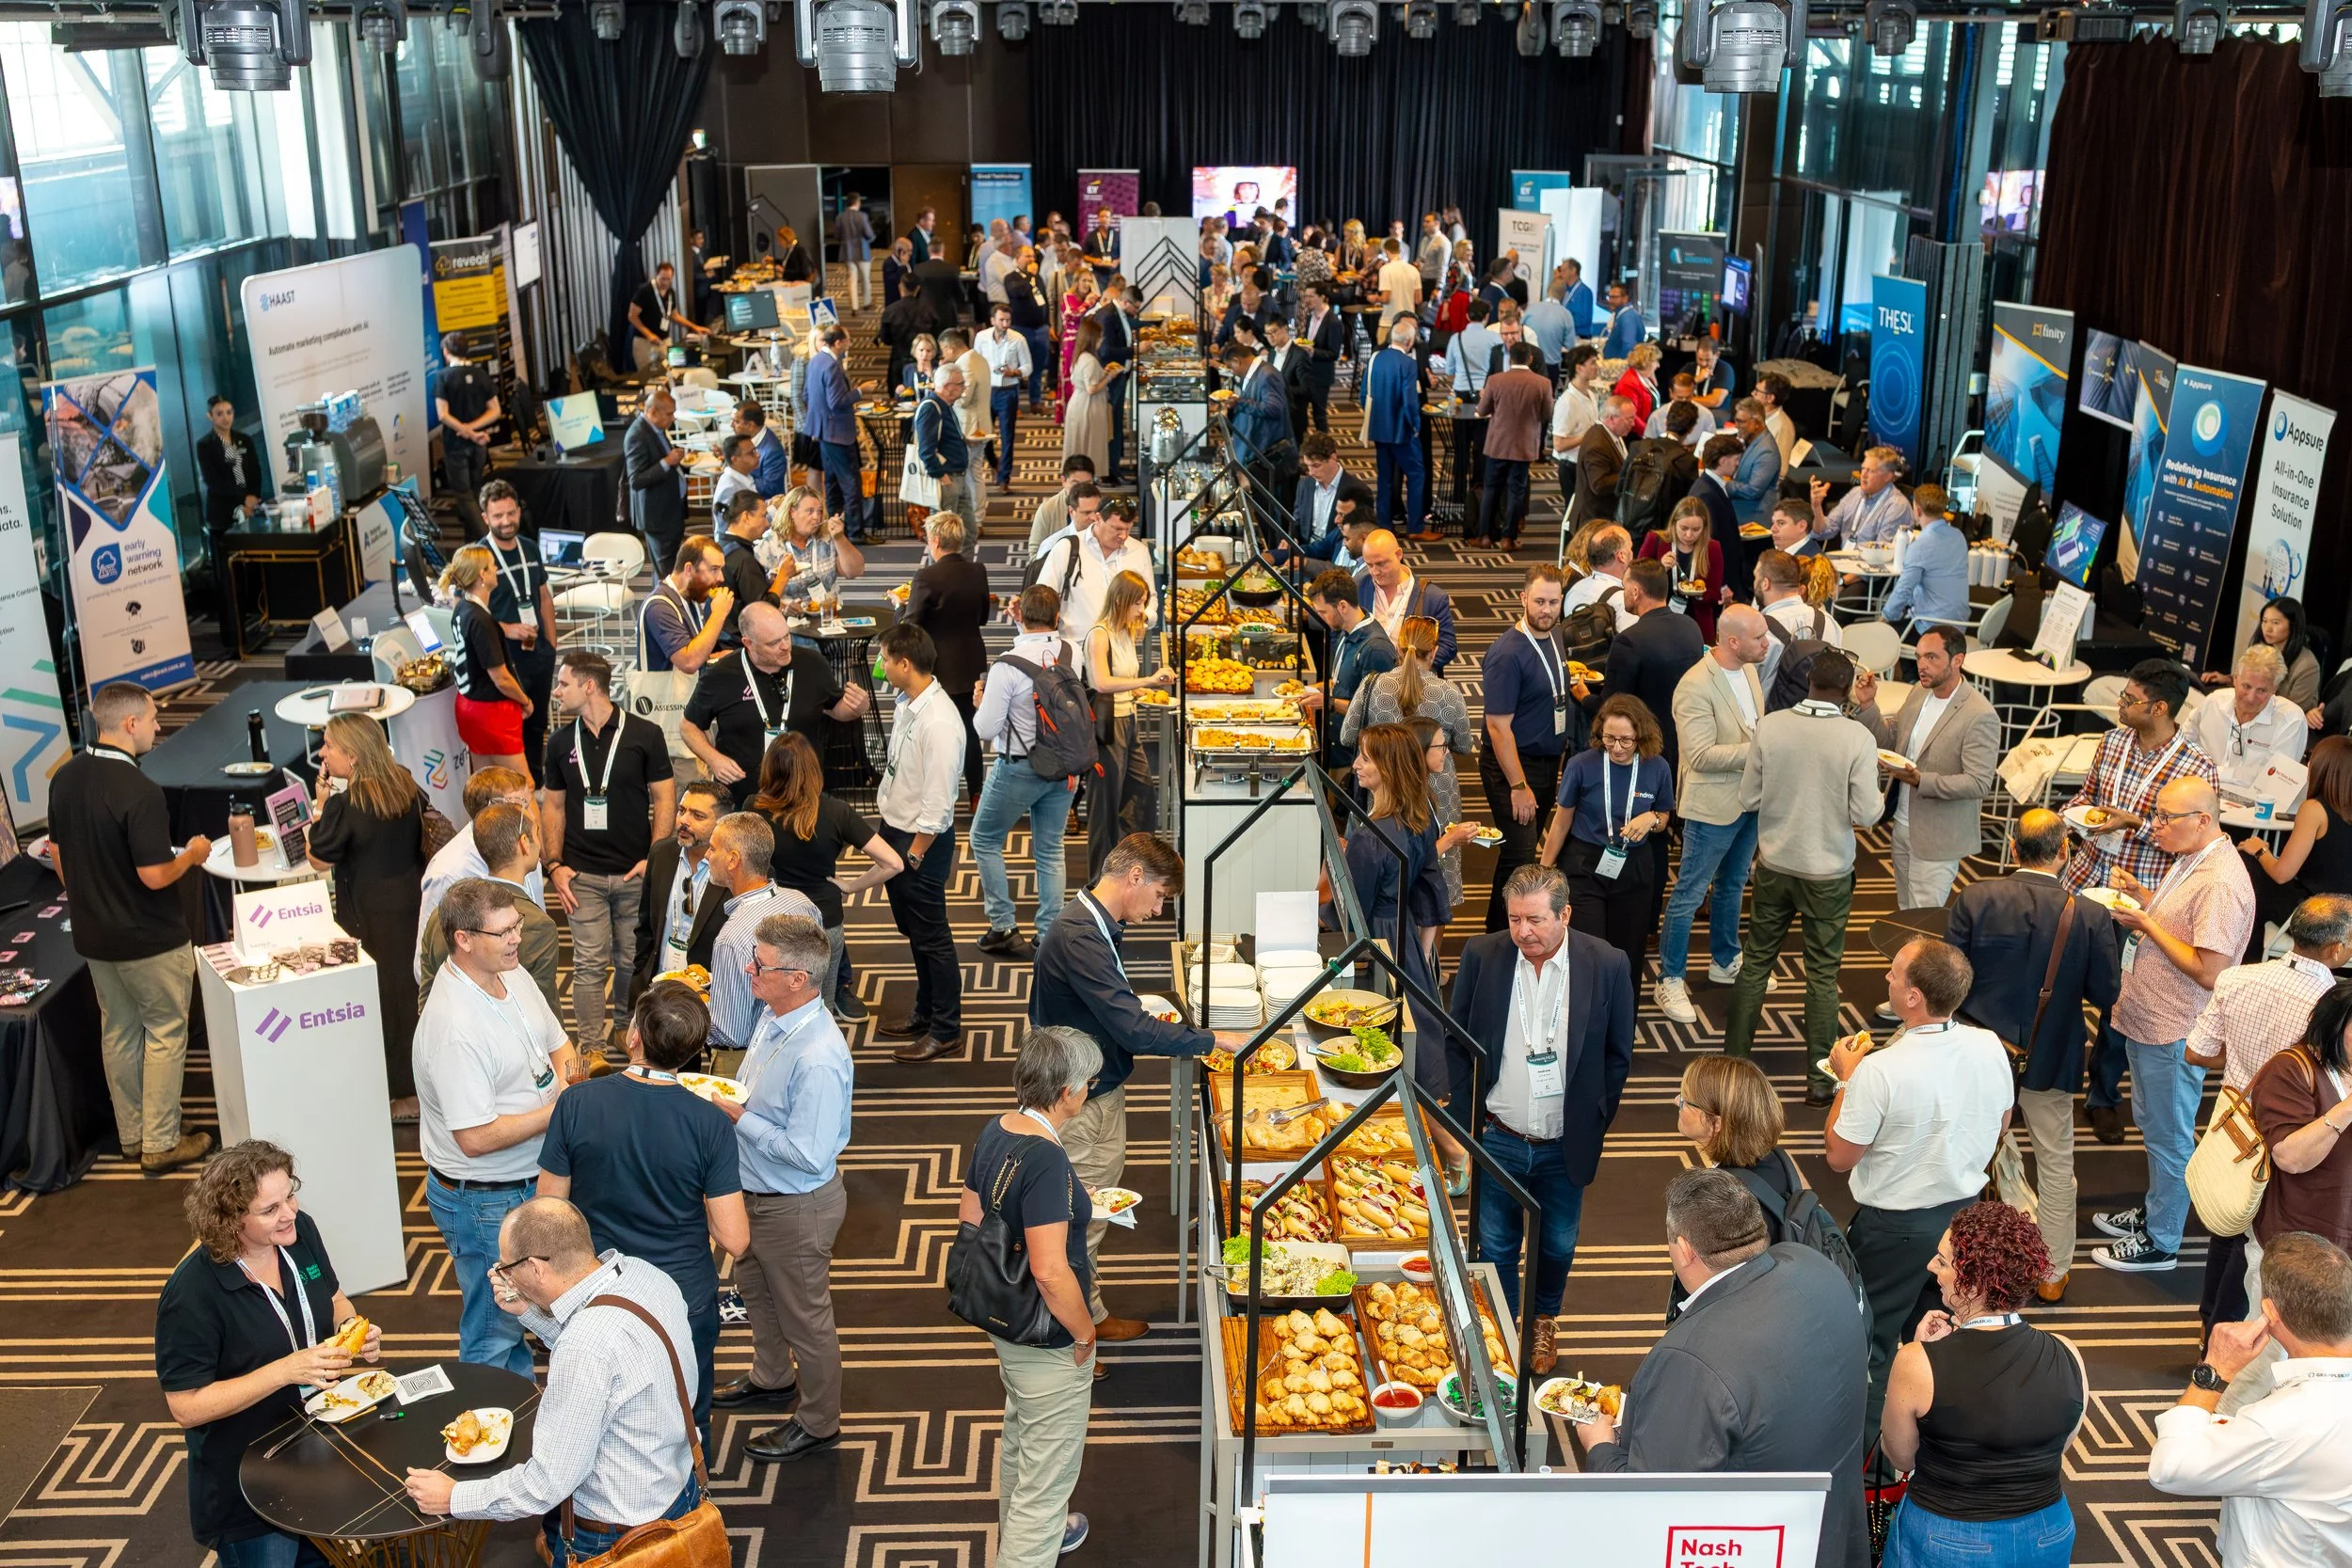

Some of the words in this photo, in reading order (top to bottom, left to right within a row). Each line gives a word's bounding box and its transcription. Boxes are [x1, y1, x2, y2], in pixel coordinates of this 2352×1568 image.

[269, 291, 295, 307] HAAST
[2287, 421, 2324, 451] Appsure
[2163, 472, 2178, 485] with
[2193, 481, 2233, 499] Automation
[2166, 458, 2202, 479] Redefining
[2202, 468, 2237, 487] Insurance
[2274, 459, 2314, 489] All-in-One
[2272, 481, 2310, 511] Insurance
[2271, 503, 2303, 531] Solution
[124, 539, 146, 552] early
[126, 546, 162, 563] warning
[127, 558, 164, 577] network
[278, 902, 324, 920] Entsia
[299, 1002, 366, 1030] Entsia
[1680, 1539, 1742, 1556] Nash
